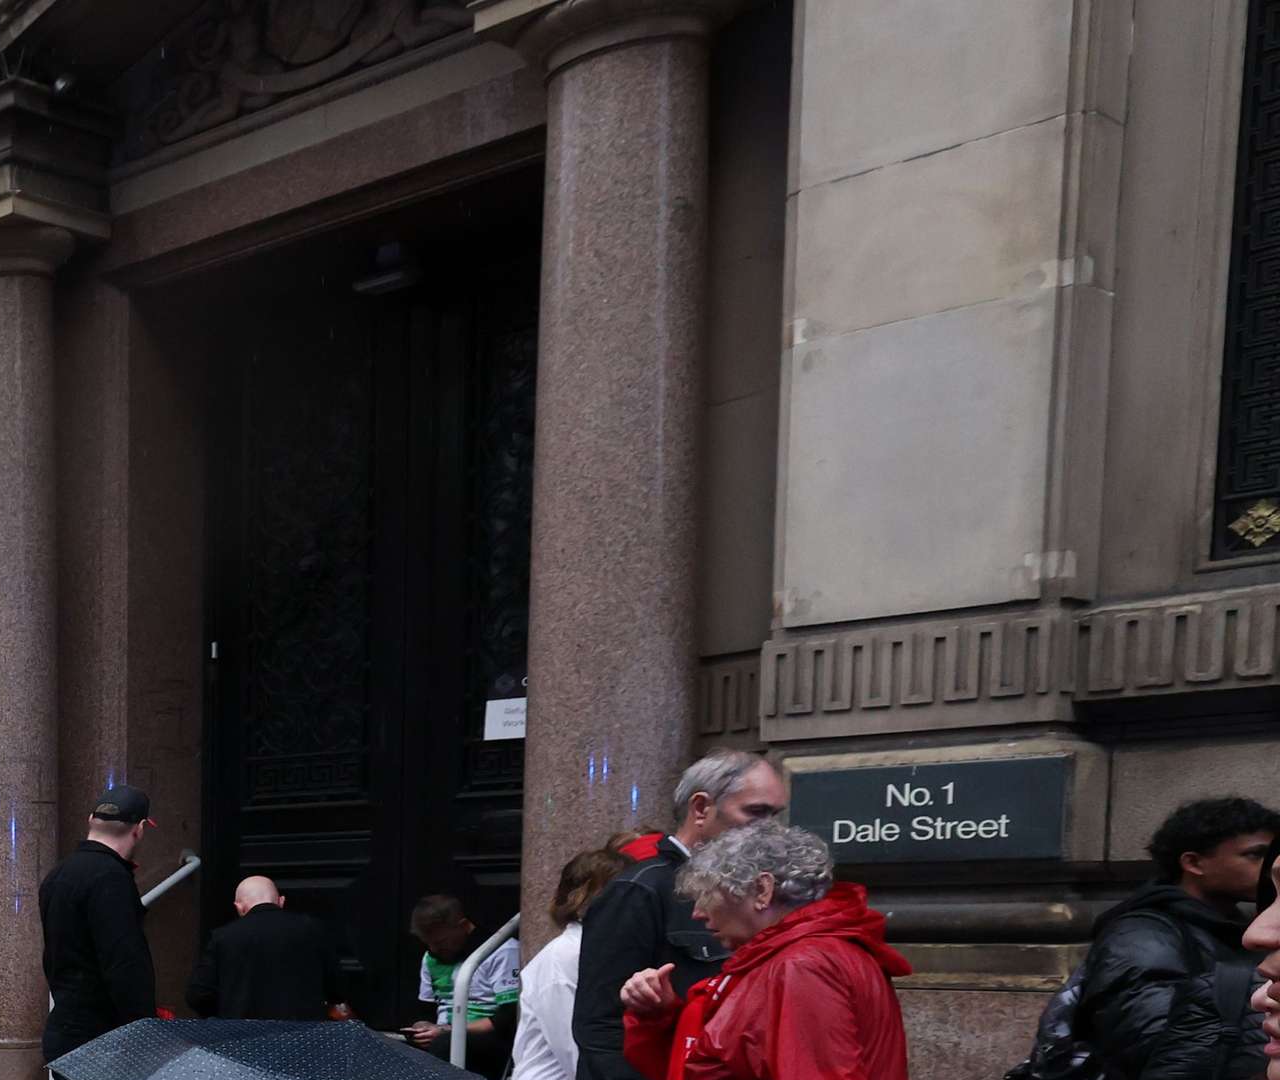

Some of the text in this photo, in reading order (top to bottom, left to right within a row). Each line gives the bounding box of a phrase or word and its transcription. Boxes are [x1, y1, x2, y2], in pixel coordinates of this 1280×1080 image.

[941, 781, 955, 805] 1
[832, 814, 1011, 843] Dale Street
